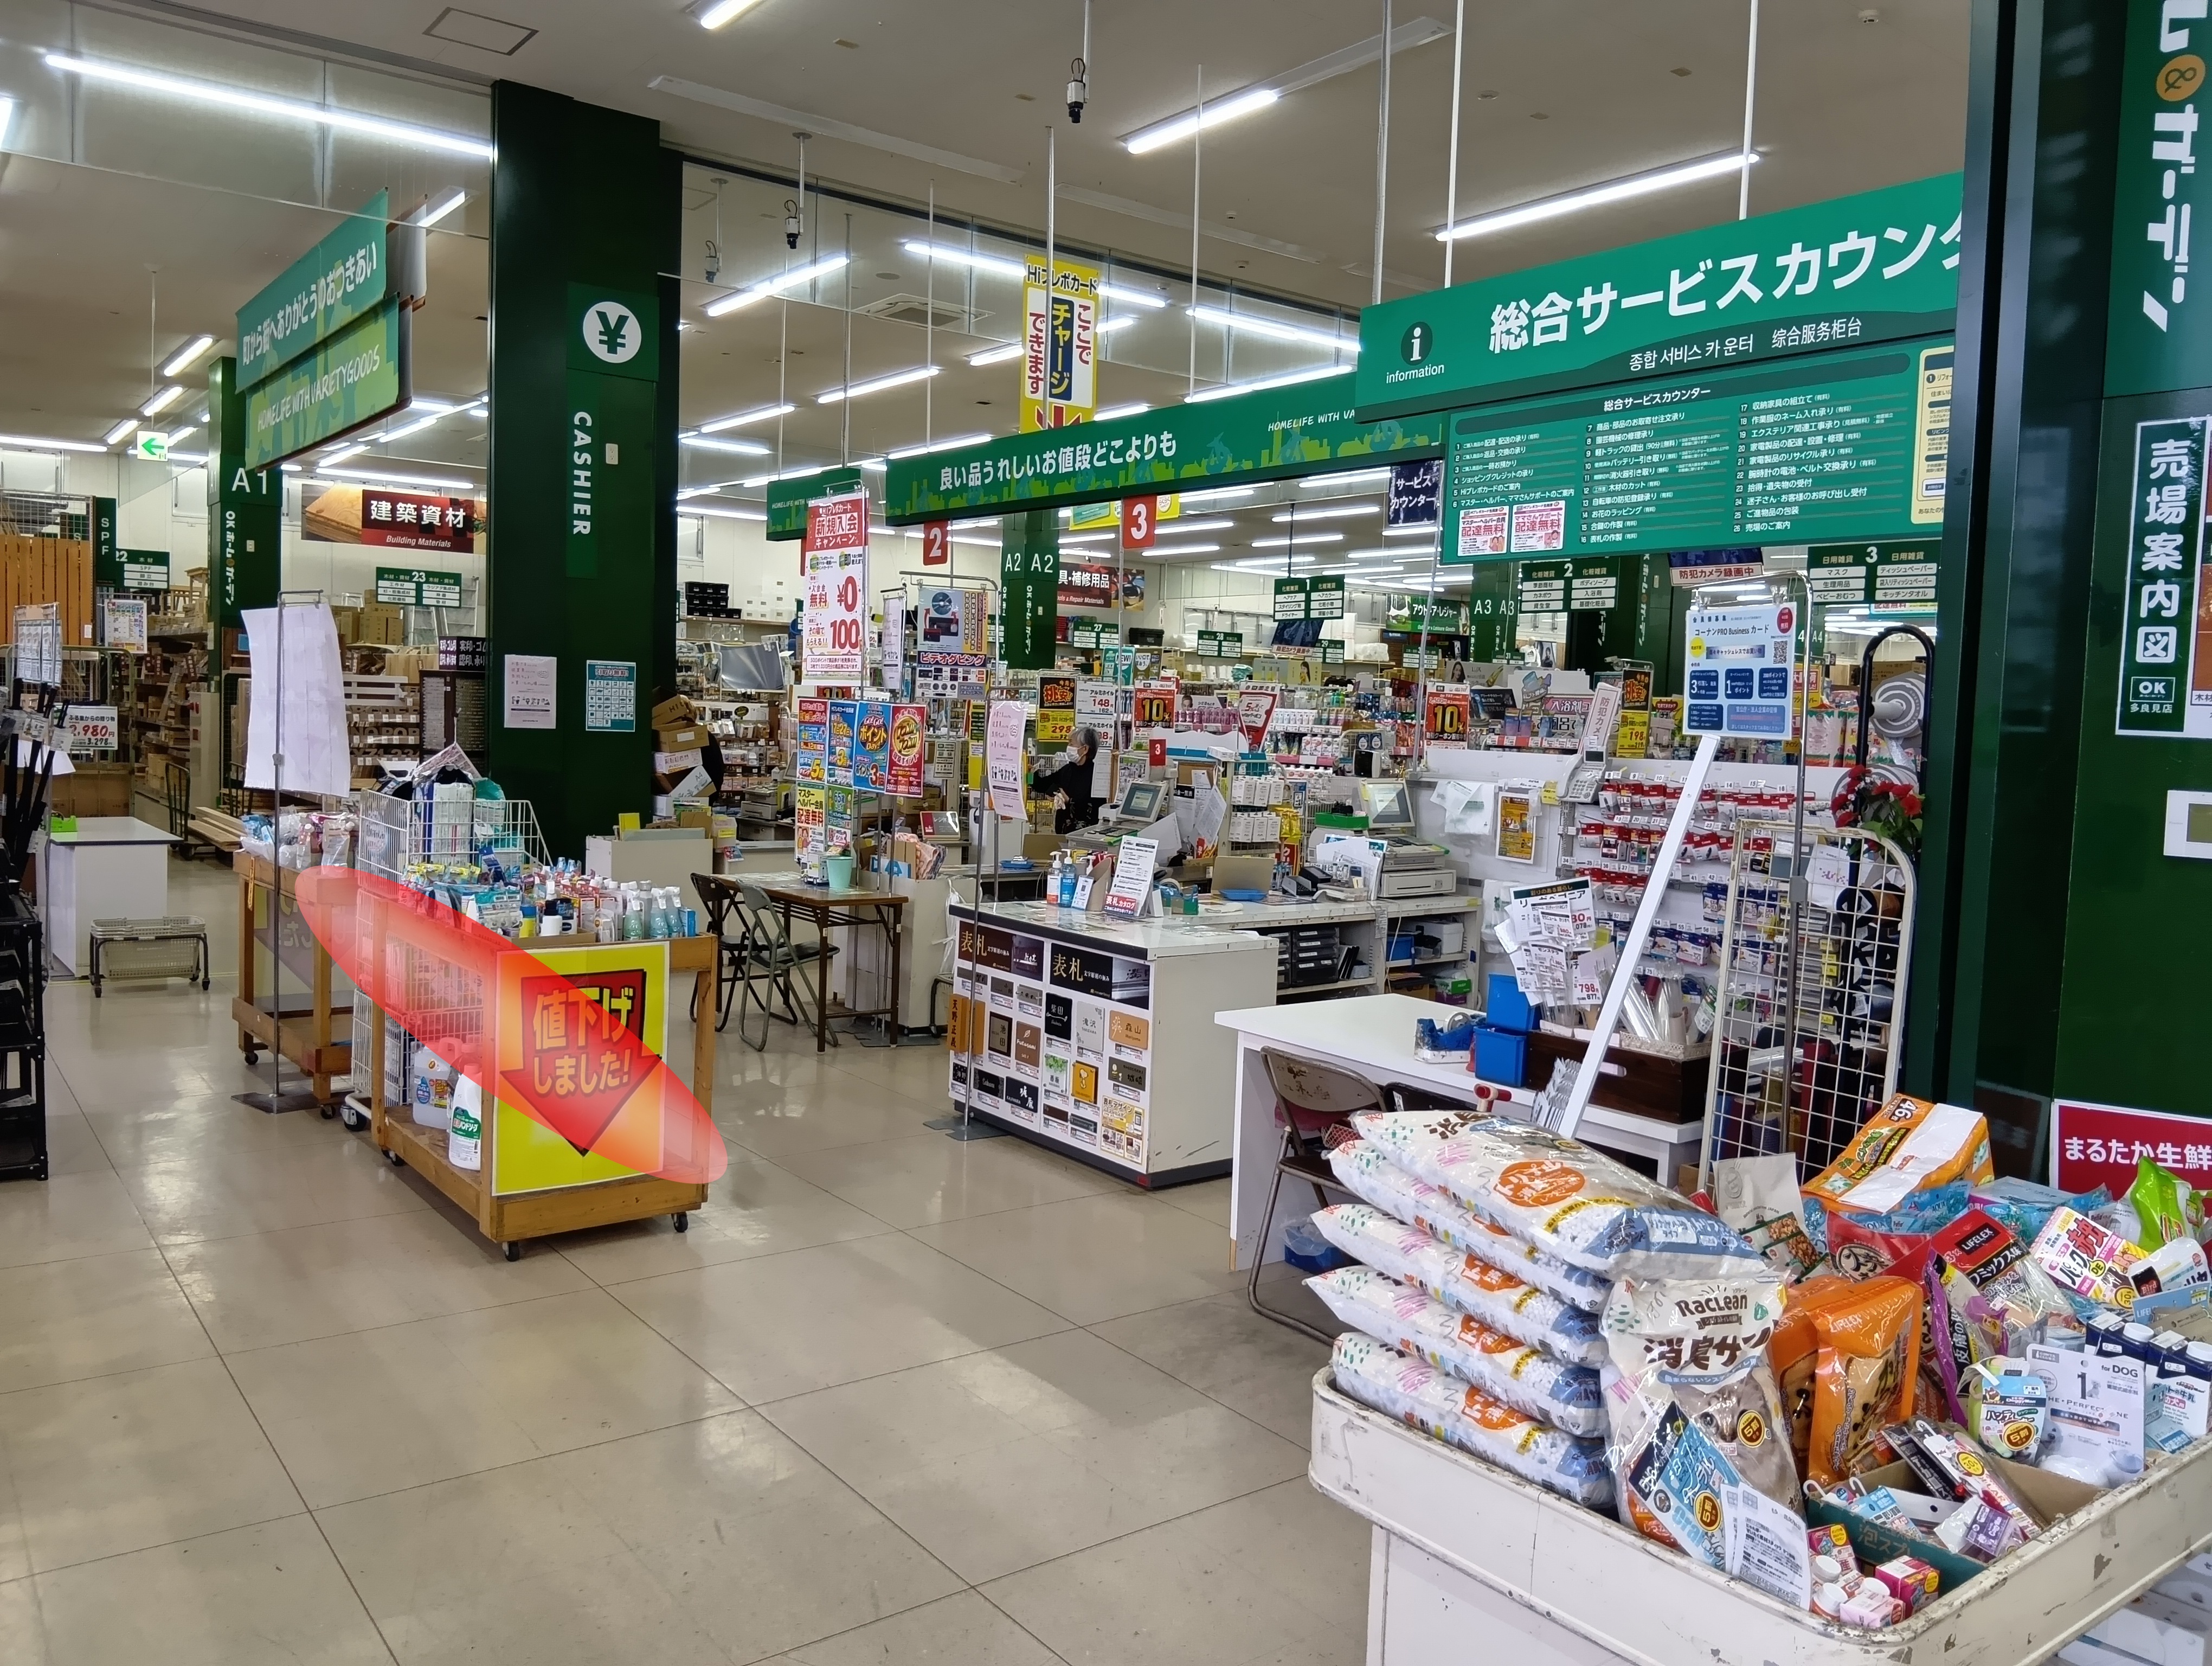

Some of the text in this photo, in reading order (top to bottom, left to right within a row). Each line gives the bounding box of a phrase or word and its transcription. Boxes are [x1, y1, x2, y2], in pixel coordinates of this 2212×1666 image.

[243, 241, 376, 366] 町から街へありがとうのおつきあい
[1076, 304, 1091, 365] ここで
[1771, 316, 1862, 349] 综合服务柜台
[1028, 312, 1045, 394] できます
[1051, 303, 1071, 395] チャージ
[1629, 350, 1657, 371] 종합
[1660, 344, 1702, 366] 서비스
[1386, 362, 1444, 385] information
[1604, 387, 1711, 412] 総合サービスカウンター
[1752, 395, 1812, 411] 収納家具の組立て
[258, 403, 291, 432] HOMELIFE
[292, 392, 310, 414] WITH
[1752, 408, 1834, 425] 作業服のネーム入れ承り
[1268, 411, 1340, 432] HOMELIFE WITH
[1596, 412, 1685, 432] 商品・部品のお取寄せ注文承り
[1751, 420, 1840, 438] エクステリア関連工事承り
[940, 431, 1176, 491] 良い品うれしいお値段どこよりも
[1750, 448, 1835, 465] 家電製品のリサイクル承り
[573, 411, 592, 535] CASHIER
[1462, 469, 1533, 484] ショッピングクレジットの承り
[1748, 460, 1856, 479] 腕時計の電池・ベルト交換承り
[232, 467, 268, 495] A1
[1396, 476, 1432, 490] サービス
[1609, 482, 1645, 491] 木材のカット
[1748, 478, 1812, 492] 拾得・遺失物の受付
[1461, 483, 1521, 496] Hiプレポカードのご案内
[1747, 487, 1867, 505] 迷子さん・お客様のお呼び出し受付
[1390, 496, 1437, 511] カウンター
[1592, 493, 1657, 506] 自転車の防犯登録承り
[226, 511, 236, 529] OK
[370, 500, 466, 528] 建築資材
[1591, 507, 1642, 518] お花のラッピング
[1747, 506, 1799, 518] ご進物品の包装
[815, 512, 858, 538] 新規入会
[1130, 503, 1148, 540] 3
[1515, 518, 1561, 533] 配達無料
[1745, 521, 1790, 532] 売場のご案内
[101, 518, 110, 555] SPF
[1461, 523, 1504, 537] 配達無料
[1590, 533, 1623, 543] 表札の作製
[386, 535, 451, 548] Building Materials
[815, 535, 856, 549] キャンペーン
[929, 527, 942, 558] 2
[1822, 551, 1924, 564] 日用雑貨 日用雑貨
[1866, 546, 1878, 563] 3
[2136, 439, 2191, 663] 売場案内図
[1005, 553, 1021, 572] A2
[1031, 553, 1053, 573] A2
[1564, 563, 1573, 577] 2
[1880, 565, 1933, 573] ティッシュペーパー
[412, 571, 426, 582] 23
[1058, 570, 1110, 589] 具・補修用品
[1679, 567, 1755, 580] 防犯カメラ録画中
[1306, 579, 1310, 591] 1
[1880, 578, 1932, 586] 袋入りティッシュペーパー
[809, 593, 828, 607] 無料
[837, 575, 858, 612] ¥0
[1026, 585, 1033, 601] OK
[1412, 604, 1458, 618] アウトア・レジャー
[1474, 599, 1491, 614] A3
[1500, 600, 1514, 616] A3
[831, 618, 860, 650] 100
[1216, 632, 1224, 640] 28
[1695, 624, 1770, 637] コーナンPRO Business カード
[1812, 630, 1823, 644] A4
[921, 652, 985, 667] ビデオダビング
[1691, 680, 1697, 694] 3
[1726, 680, 1732, 694] 1
[2139, 681, 2166, 694] OK
[2130, 703, 2173, 714] 多良見店
[860, 725, 887, 742] ポイント
[1051, 725, 1072, 734] 298
[1629, 731, 1644, 741] 198
[1155, 743, 1161, 754] 3
[798, 788, 815, 796] マスター
[797, 808, 824, 827] 配達無料
[1105, 895, 1136, 908] 表札カタログ
[961, 931, 988, 957] 表札
[1052, 953, 1084, 982] 表札
[1051, 1004, 1063, 1015] 柴田
[533, 987, 633, 1050] 値下げ
[1082, 1017, 1096, 1028] 滝沢
[1125, 1022, 1142, 1035] 森山
[534, 1049, 631, 1095] しました!
[1103, 1097, 1133, 1114] 表札デザイン
[2064, 1136, 2212, 1171] まるたか生鮮
[1962, 1228, 1995, 1250] LIFELEX
[2140, 1280, 2157, 1296] Bird
[1675, 1294, 1748, 1317] RacLean
[2112, 1364, 2138, 1378] DOG
[1744, 1420, 1760, 1436] 5割
[2009, 1428, 2030, 1443] 5割
